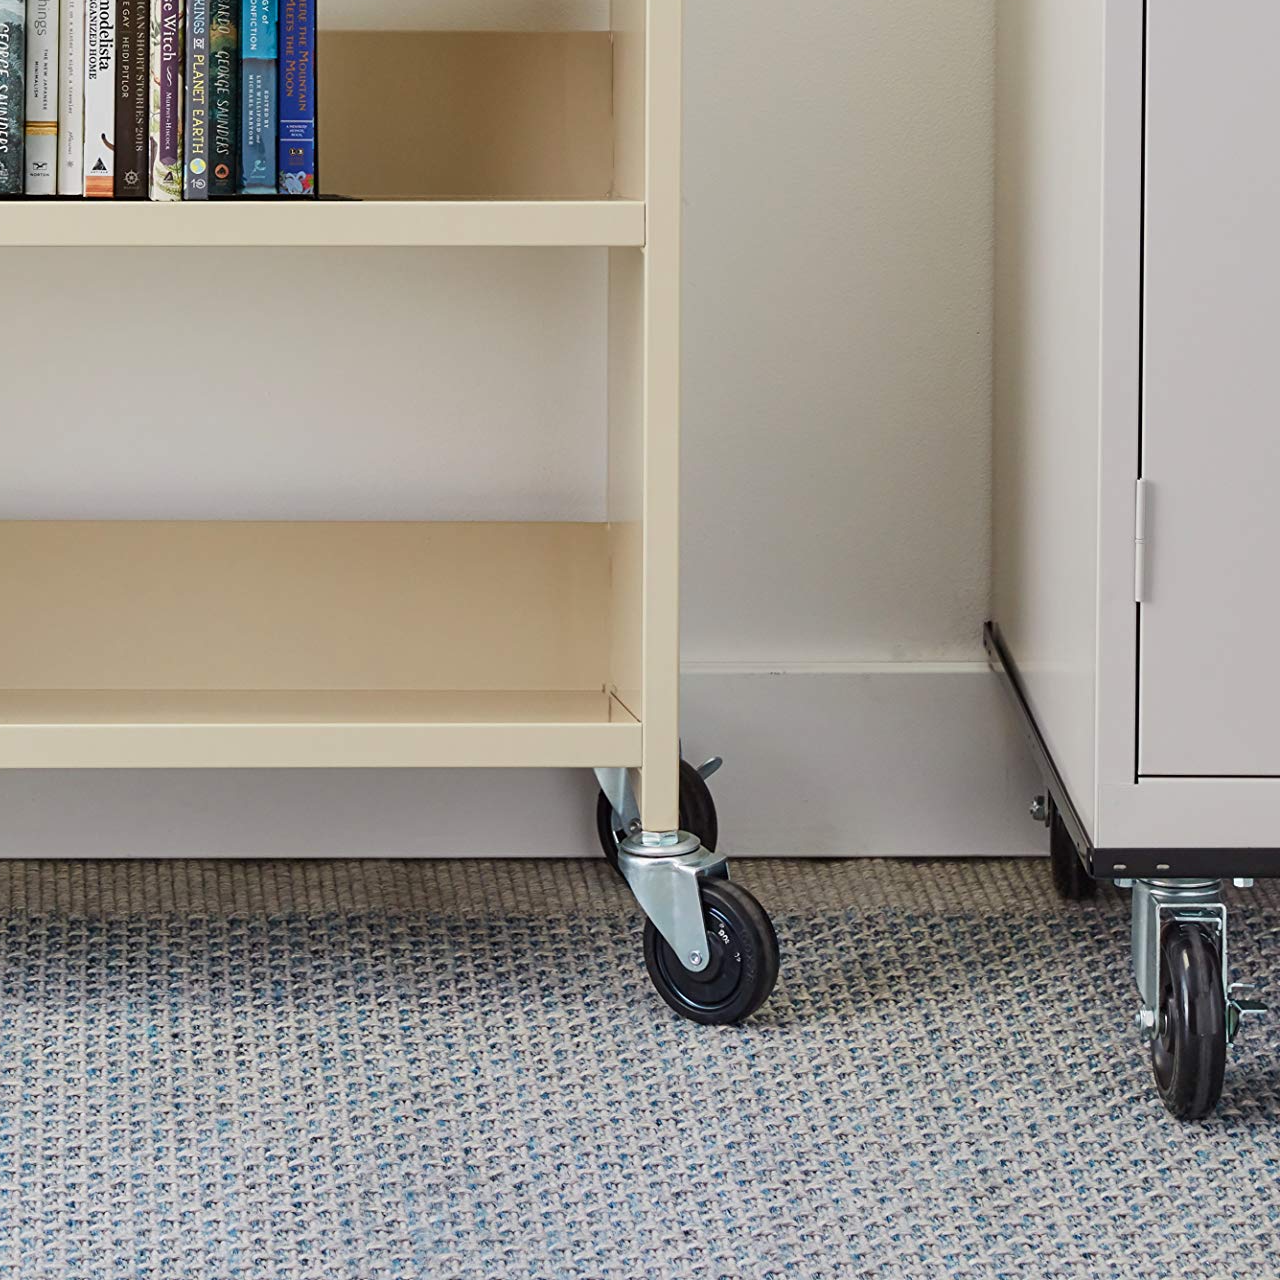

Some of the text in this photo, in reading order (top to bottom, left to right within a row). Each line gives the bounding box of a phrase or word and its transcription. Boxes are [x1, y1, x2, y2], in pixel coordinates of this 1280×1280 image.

[122, 9, 130, 28] GAY
[122, 36, 130, 62] HEIDI
[136, 32, 145, 71] SHORT
[163, 14, 177, 61] Witch
[195, 37, 205, 49] OF
[88, 48, 97, 80] HOME
[121, 65, 130, 98] PITLOR
[192, 54, 205, 104] PLANET
[135, 74, 144, 124] STORIES
[214, 51, 230, 155] GEORGE SAUNDERS
[135, 127, 144, 152] 2018
[192, 109, 204, 154] EARTH
